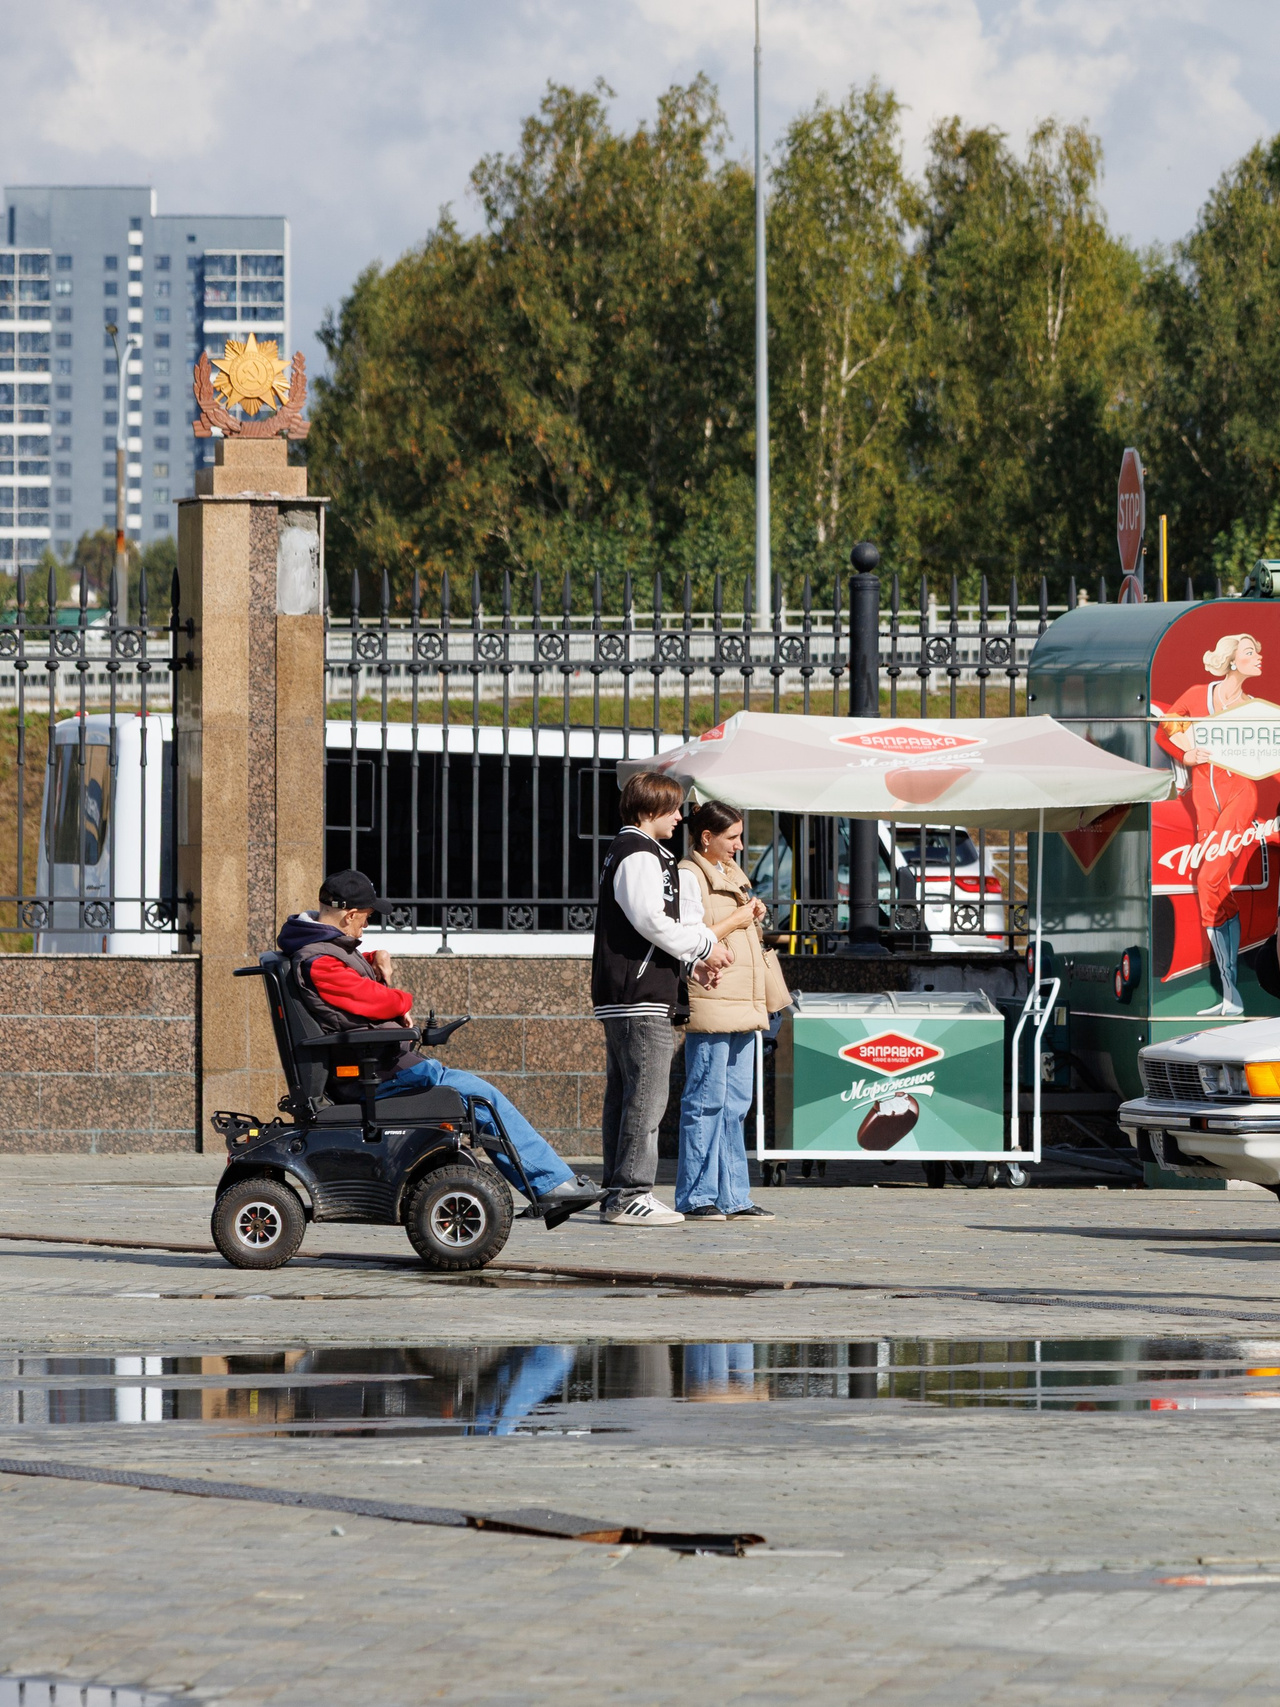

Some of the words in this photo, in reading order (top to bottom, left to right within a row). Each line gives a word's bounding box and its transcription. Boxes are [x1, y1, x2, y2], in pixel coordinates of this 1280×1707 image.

[1118, 493, 1140, 531] STOP
[860, 735, 957, 746] ЗАПРАВКА
[847, 750, 982, 768] Мороженое
[1221, 749, 1248, 757] КАФЕ
[1250, 749, 1256, 757] В
[859, 1046, 924, 1058] ЗАПРАВКА
[841, 1071, 936, 1102] Мороженое
